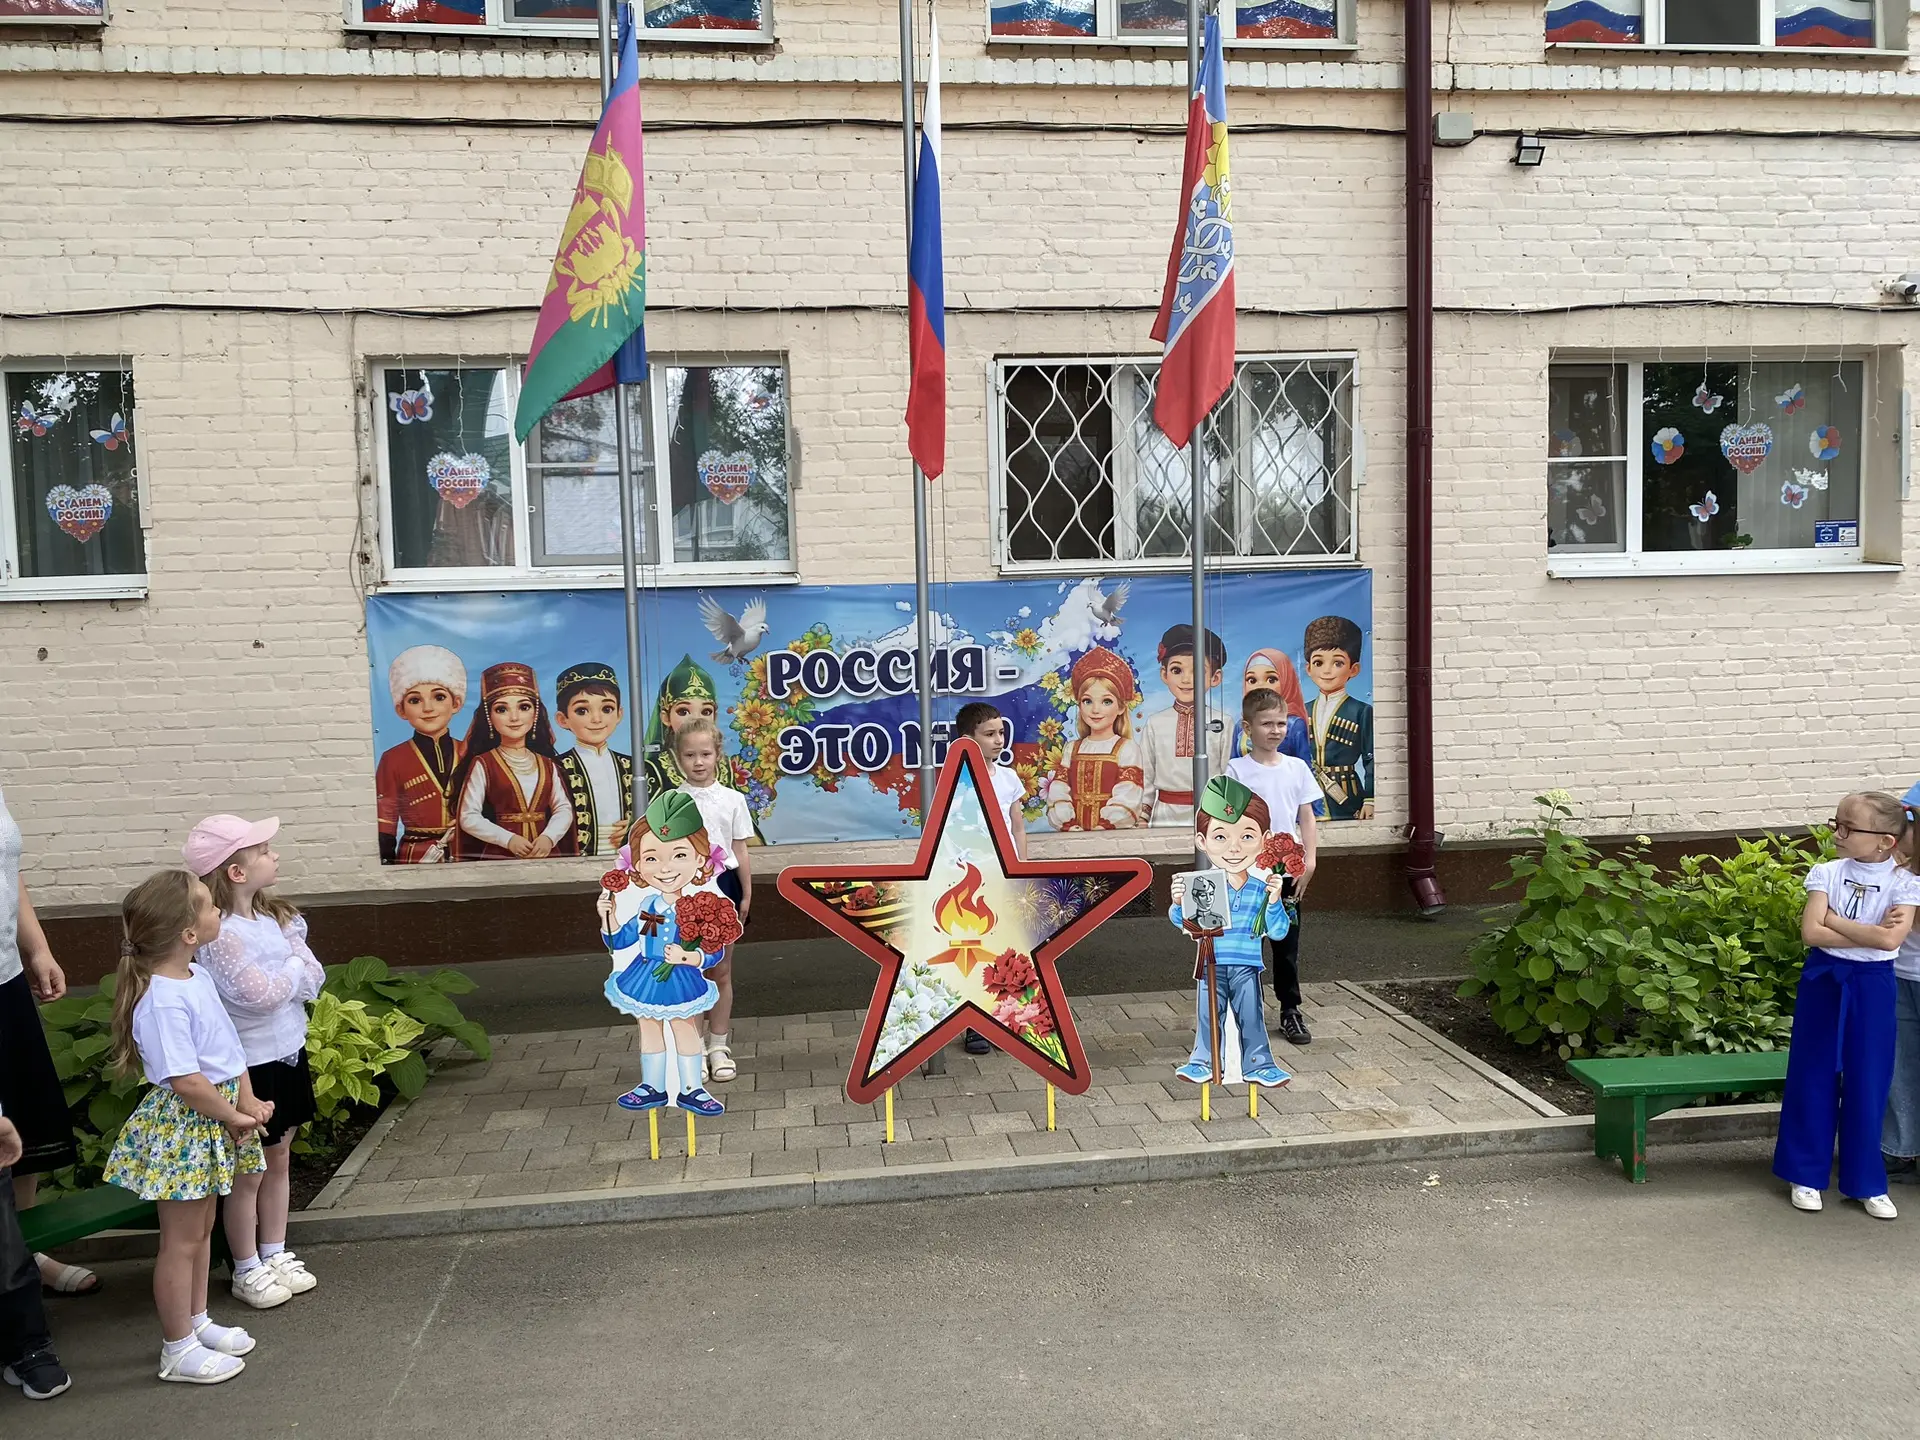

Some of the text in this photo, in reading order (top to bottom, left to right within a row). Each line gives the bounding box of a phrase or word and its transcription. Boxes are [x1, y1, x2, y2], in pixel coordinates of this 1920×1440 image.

[1729, 436, 1765, 445] С ДНЕМ
[1728, 447, 1766, 456] РОССИИ!
[438, 467, 445, 476] С
[707, 464, 748, 473] С ДНЕМ
[437, 479, 481, 488] РОССИИ!
[706, 475, 749, 484] РОССИИ!
[58, 498, 102, 508] С ДНЕМ
[58, 510, 104, 520] РОССИИ!
[767, 646, 986, 698] РОССИЯ
[778, 717, 1013, 773] ЭТО М!
